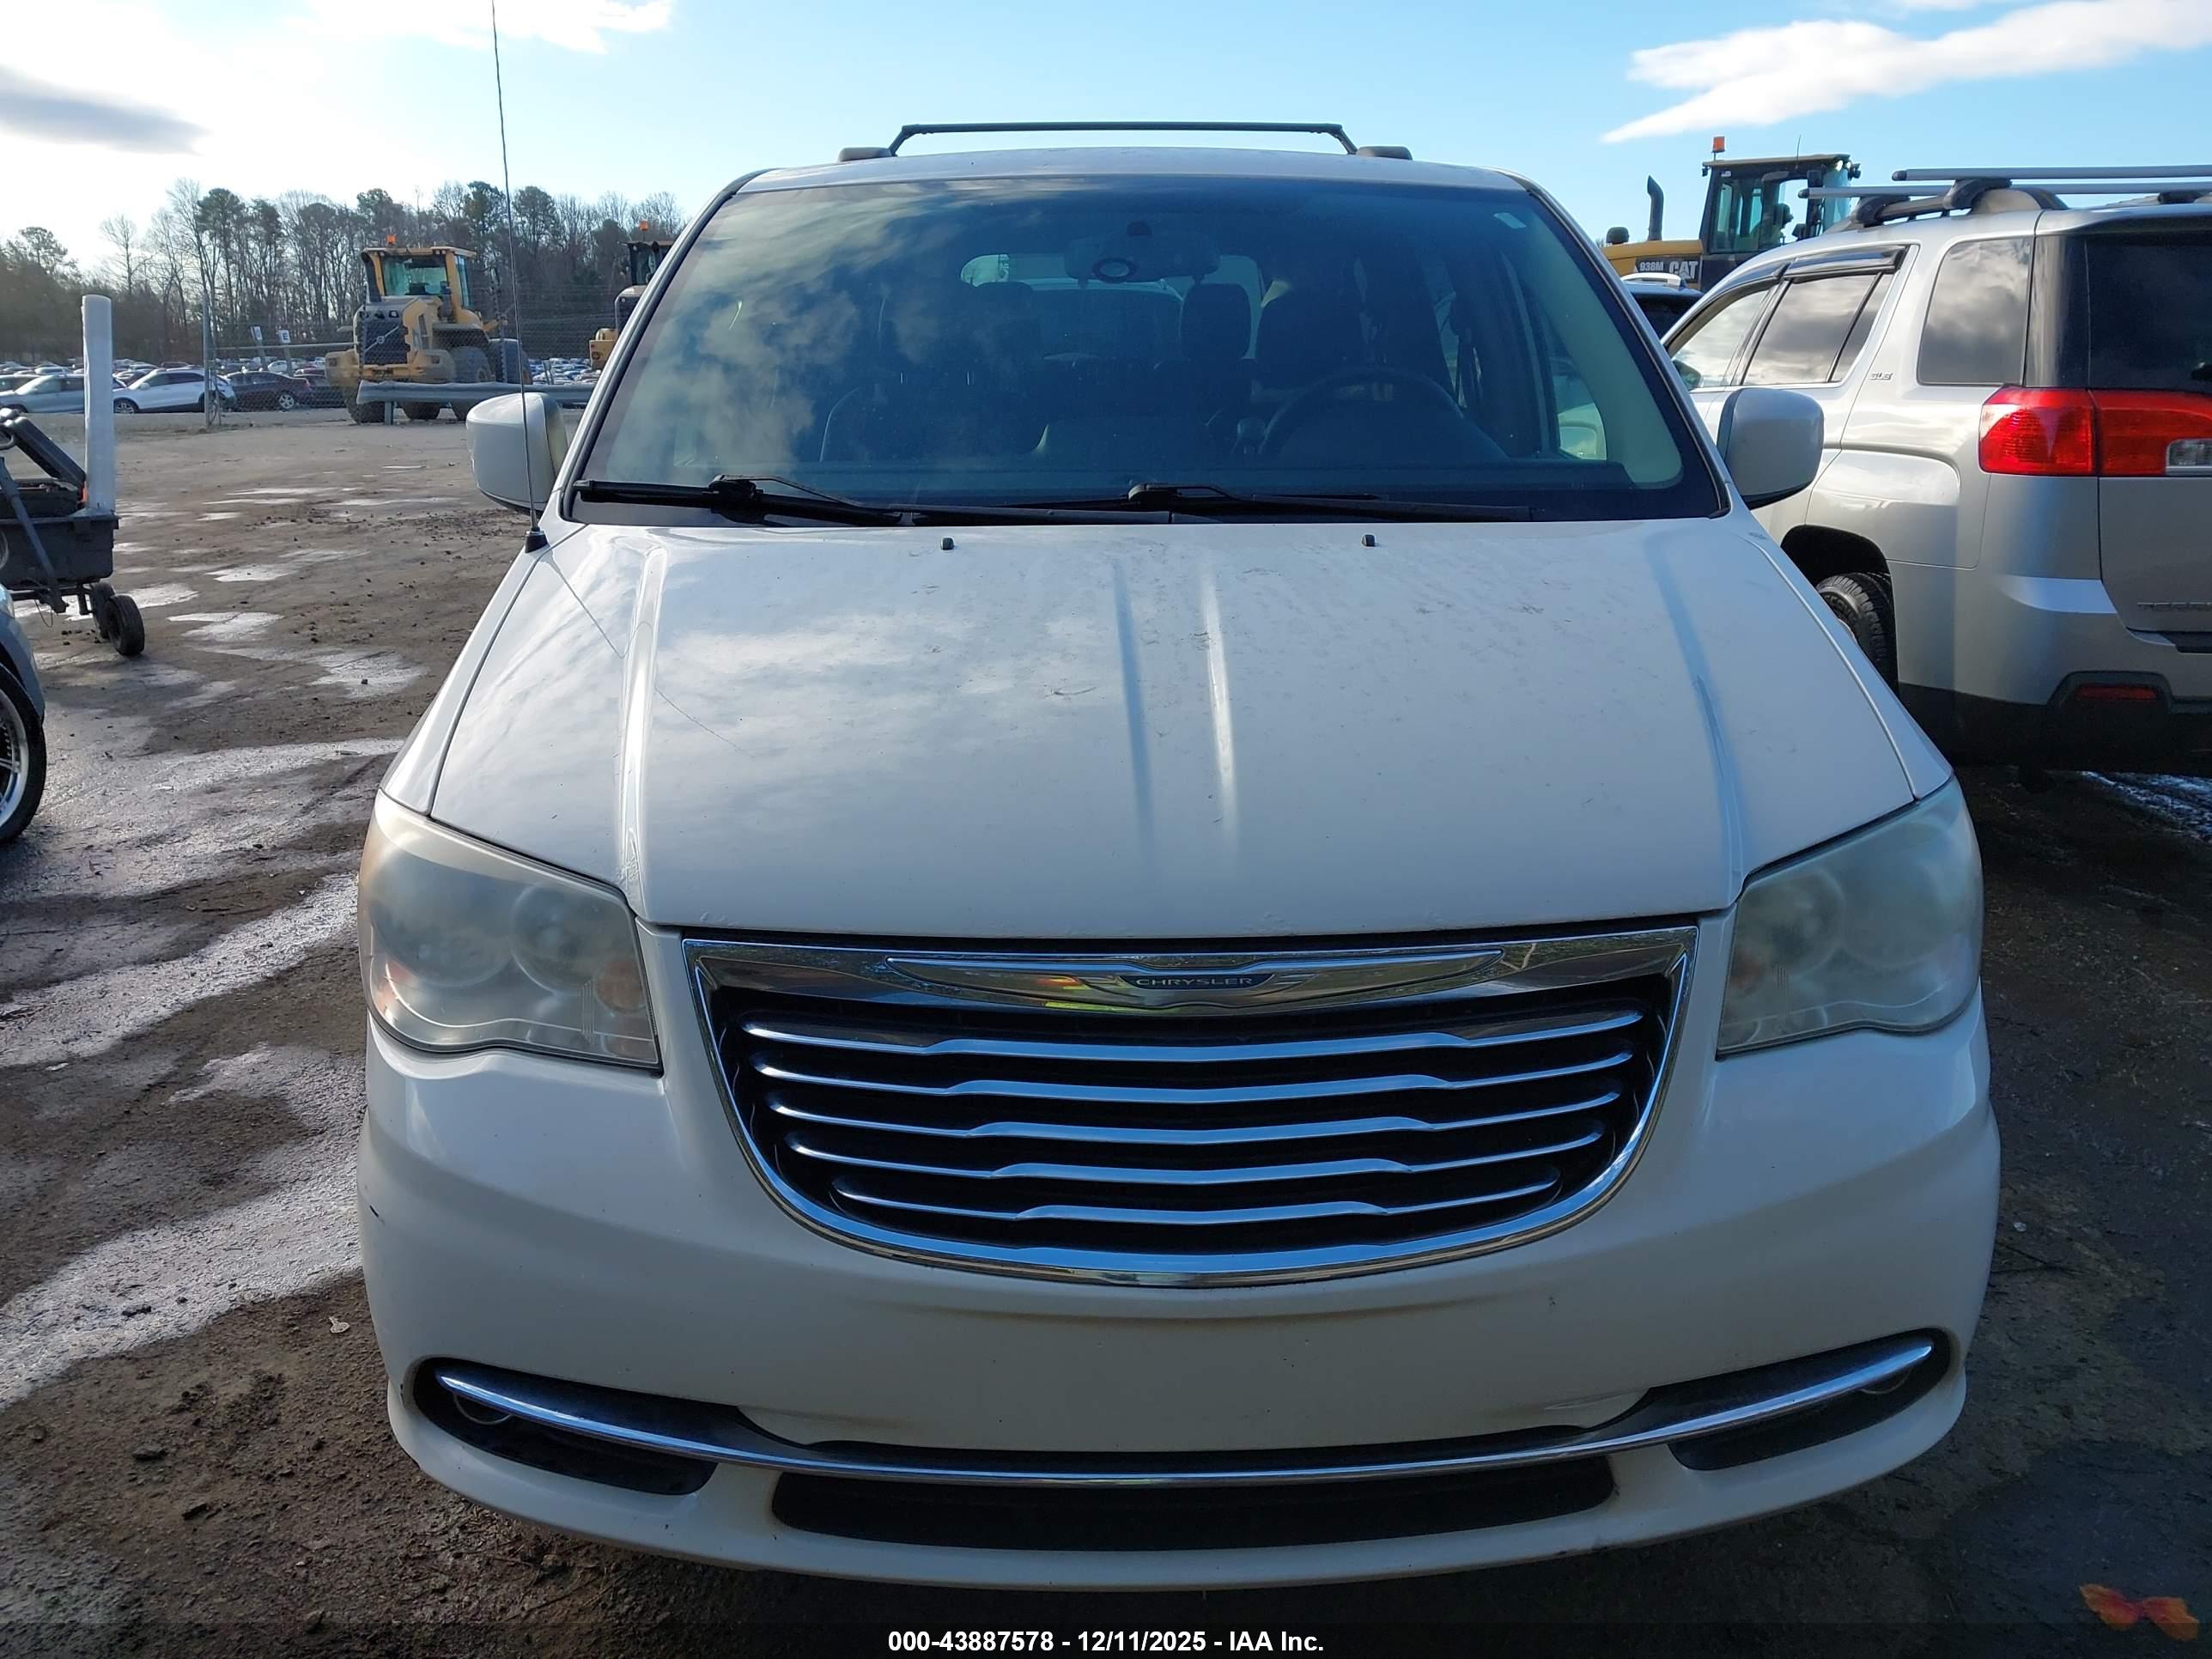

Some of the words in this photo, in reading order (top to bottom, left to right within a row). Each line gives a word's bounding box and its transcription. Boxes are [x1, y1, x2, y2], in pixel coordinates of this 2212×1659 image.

[1639, 261, 1664, 271] 938M
[1668, 260, 1698, 279] CAT
[1135, 977, 1253, 986] CHRYSLER
